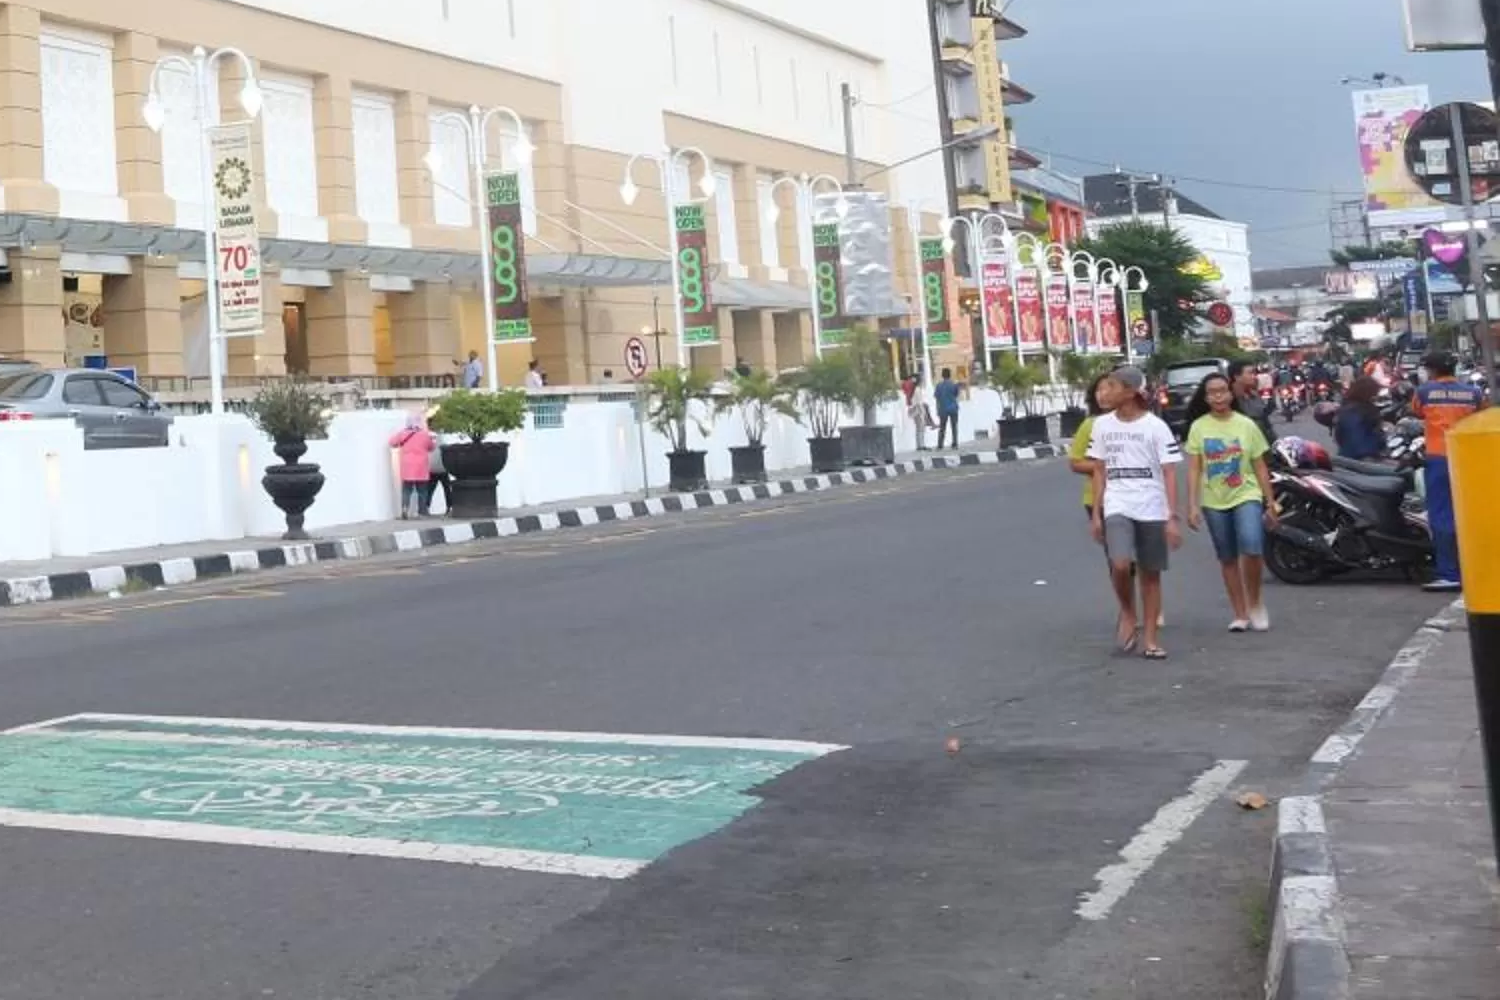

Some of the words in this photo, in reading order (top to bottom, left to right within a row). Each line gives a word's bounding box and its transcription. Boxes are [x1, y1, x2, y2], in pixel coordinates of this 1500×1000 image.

[487, 174, 517, 190] NOW
[488, 189, 519, 203] OPEN
[676, 216, 704, 229] OPEN
